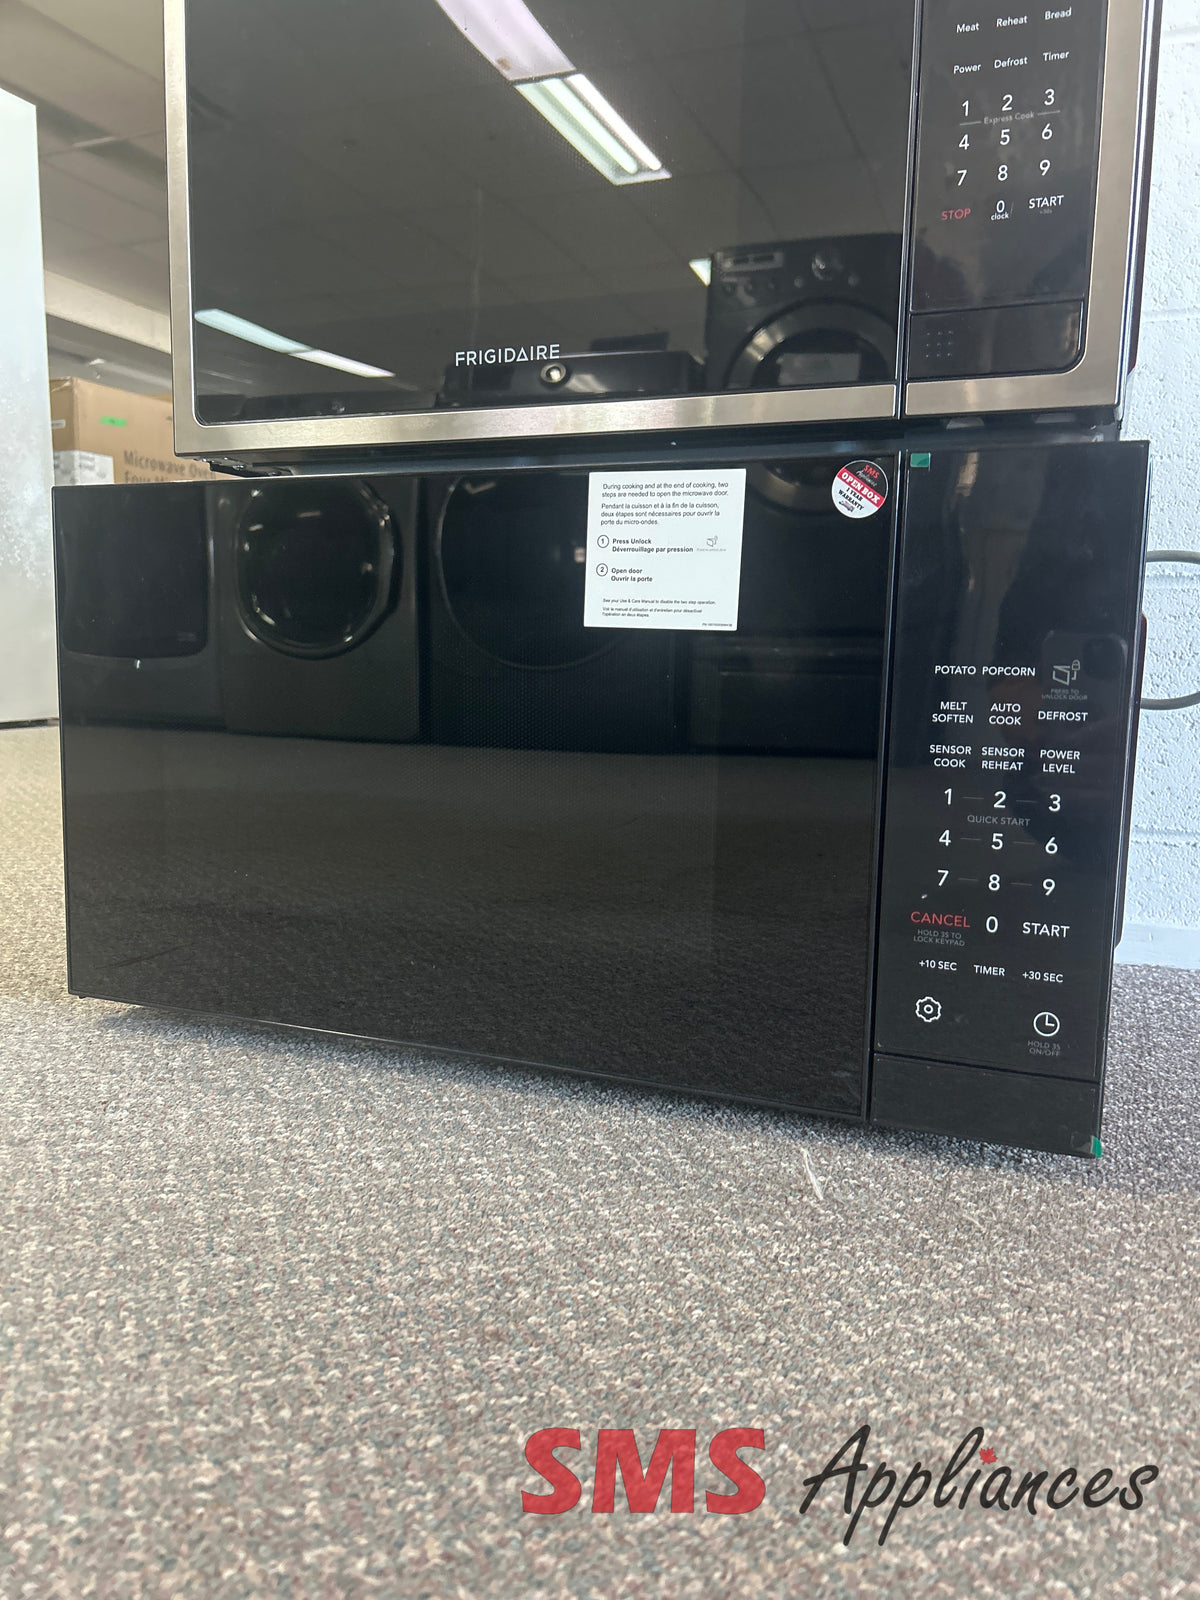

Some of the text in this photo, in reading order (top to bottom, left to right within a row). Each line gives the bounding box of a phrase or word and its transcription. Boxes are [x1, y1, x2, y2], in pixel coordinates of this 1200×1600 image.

[1045, 7, 1072, 20] Bread
[997, 16, 1027, 27] Reheat
[956, 23, 979, 33] Meat
[994, 57, 1028, 68] Defrost
[1043, 52, 1069, 62] Timer
[954, 64, 981, 74] Power
[1002, 95, 1012, 110] 2
[1044, 89, 1054, 105] 3
[962, 101, 968, 116] 1
[984, 112, 1034, 125] Express Cook
[1000, 129, 1010, 145] 5
[1042, 124, 1052, 139] 6
[959, 134, 969, 150] 4
[998, 165, 1008, 181] 8
[1040, 160, 1050, 176] 9
[957, 170, 967, 186] 7
[996, 200, 1005, 212] 0
[1029, 195, 1064, 208] START
[942, 208, 970, 220] STOP
[991, 212, 1009, 220] clock
[456, 344, 559, 366] FRIGIDAIRE
[124, 450, 186, 475] Microwave
[864, 464, 879, 478] SMS
[841, 472, 863, 490] OPEN
[862, 487, 880, 504] BOX
[839, 490, 864, 510] WARRANTY
[850, 490, 863, 501] YEAR
[935, 666, 976, 675] POTATO
[982, 667, 1036, 676] POPCORN
[940, 702, 967, 711] MELT
[991, 703, 1021, 712] AUTO
[932, 714, 974, 724] SOFTEN
[989, 716, 1021, 726] COOK
[1038, 711, 1088, 722] DEFROST
[930, 744, 972, 755] SENSOR
[982, 747, 1024, 758] SENSOR
[1040, 750, 1080, 760] POWER
[934, 758, 966, 768] COOK
[982, 760, 1023, 771] REHEAT
[1043, 763, 1075, 774] LEVEL
[944, 788, 952, 805] 1
[994, 791, 1006, 808] 2
[1049, 794, 1061, 812] 3
[967, 815, 1030, 826] QUICK START
[939, 830, 951, 846] 4
[992, 833, 1003, 849] 5
[1045, 837, 1057, 854] 6
[937, 870, 949, 886] 7
[988, 874, 1000, 891] 8
[1042, 879, 1056, 895] 9
[910, 911, 970, 928] CANCEL
[986, 916, 998, 933] 0
[918, 929, 939, 937] HOLD
[952, 931, 962, 939] TO
[1022, 922, 1070, 938] START
[935, 937, 965, 947] KEYPAD
[919, 960, 957, 971] +10 SEC
[974, 965, 1005, 976] TIMER
[1022, 971, 1063, 983] +30 SEC
[1028, 1040, 1050, 1049] HOLD
[1030, 1048, 1060, 1056] ON/OFF
